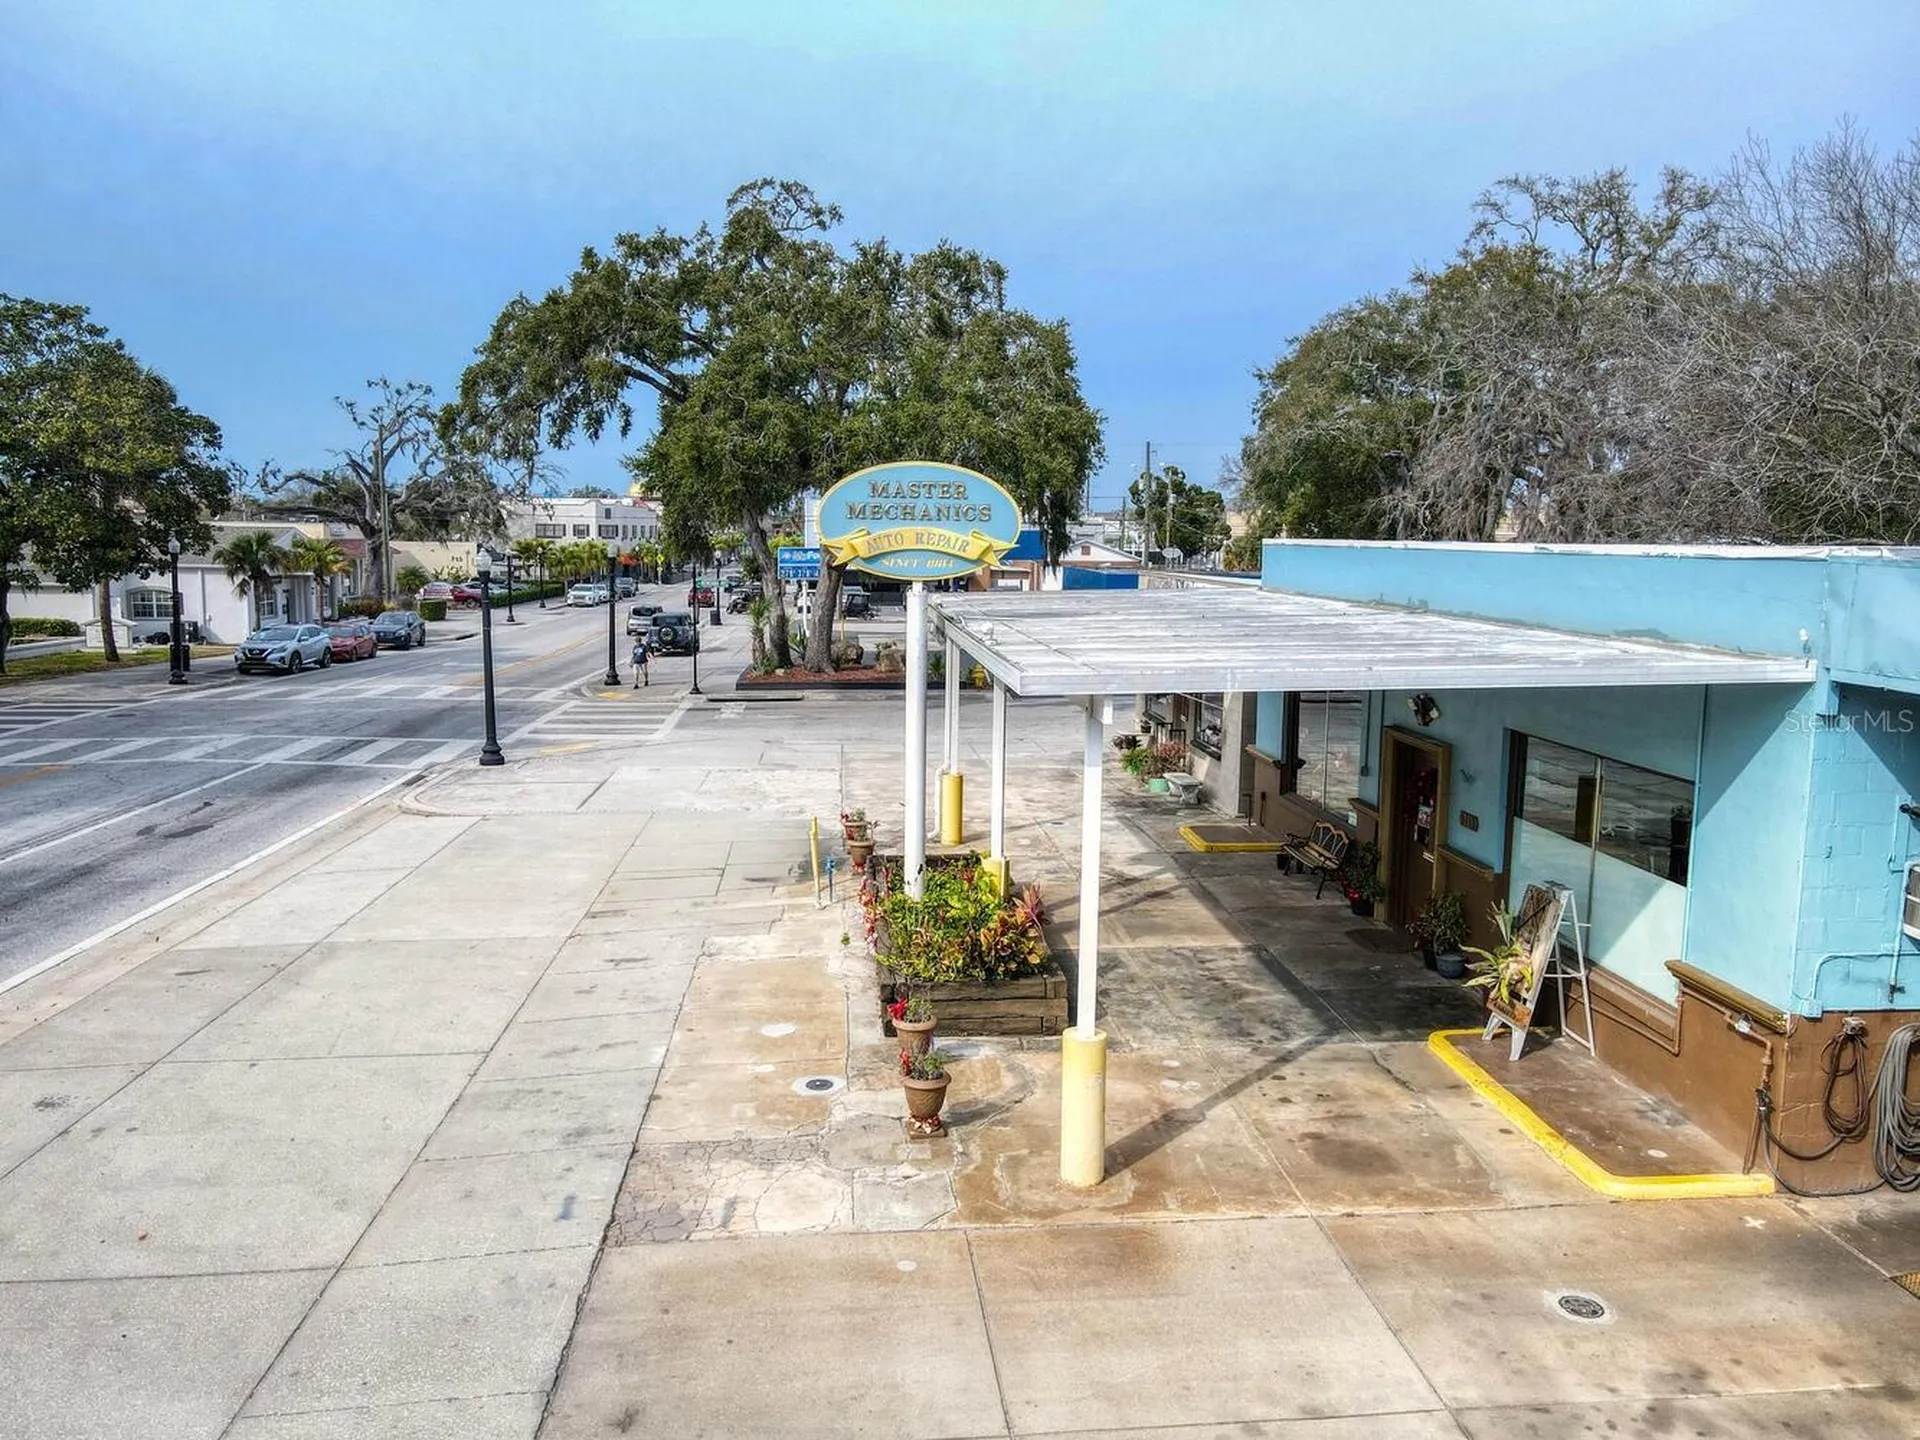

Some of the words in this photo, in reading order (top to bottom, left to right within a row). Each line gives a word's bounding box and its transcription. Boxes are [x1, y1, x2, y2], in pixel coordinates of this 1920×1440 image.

[869, 480, 968, 500] MASTER
[846, 502, 992, 521] MECHANICS
[866, 532, 904, 553] AUTO
[915, 532, 969, 553] REPAIR
